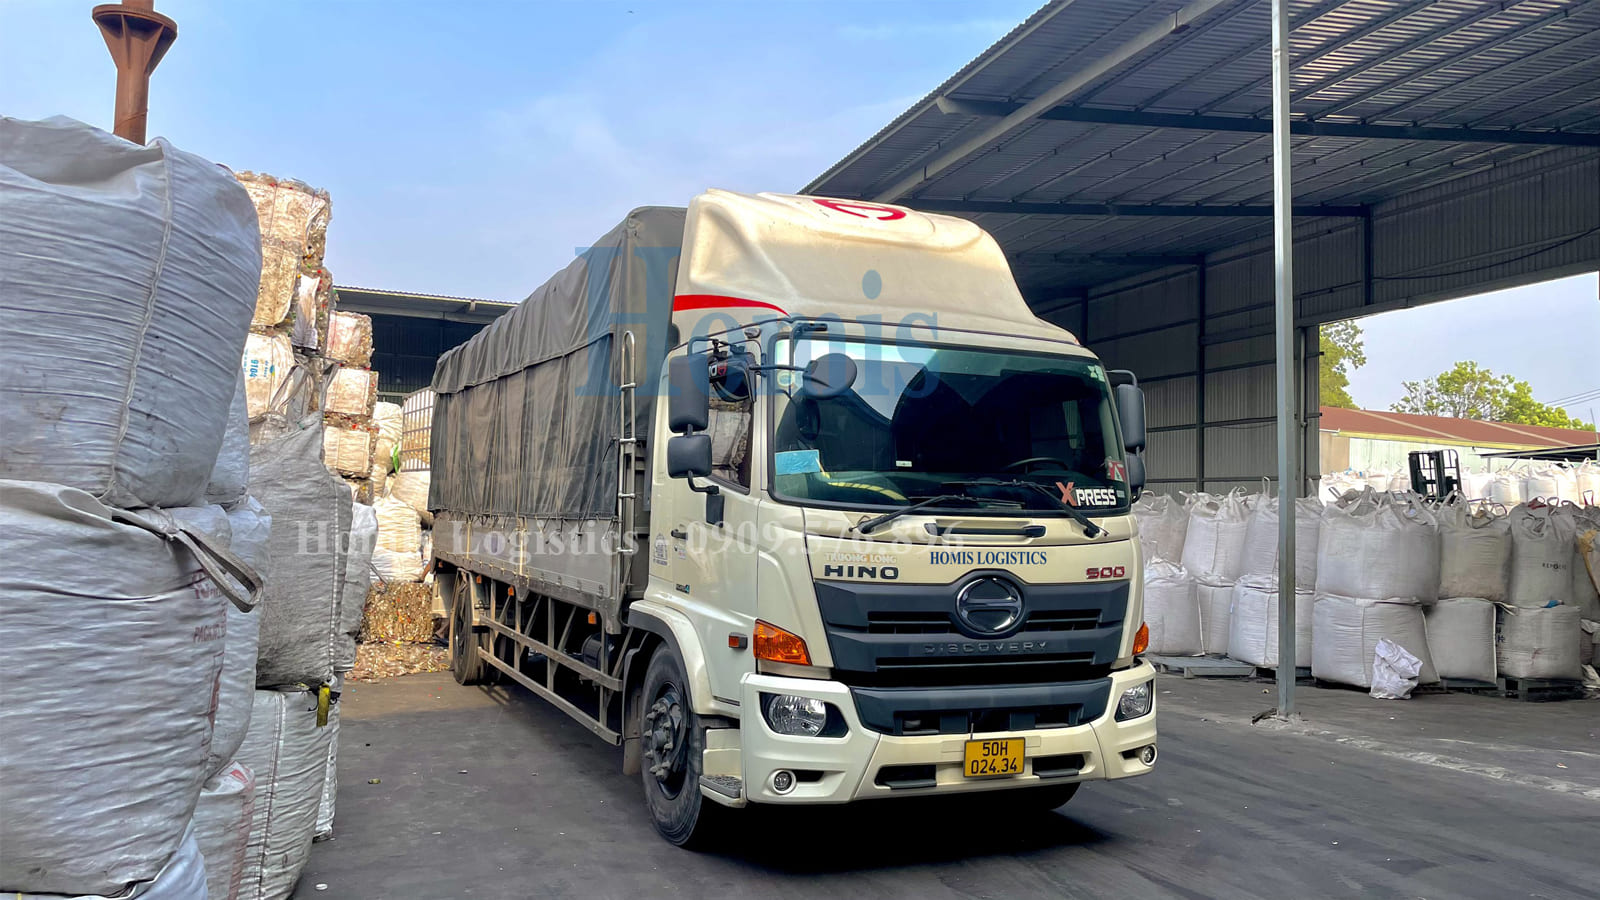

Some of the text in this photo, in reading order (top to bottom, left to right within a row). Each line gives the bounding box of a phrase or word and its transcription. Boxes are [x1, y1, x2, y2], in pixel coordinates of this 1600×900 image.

[249, 359, 259, 378] 9104
[869, 553, 897, 564] LONG
[930, 551, 1048, 565] HOMIS LOGISTICS
[824, 564, 899, 580] HINO
[1085, 566, 1125, 579] 500
[924, 641, 1047, 654] DISCOVERY
[982, 741, 1008, 757] 50H
[971, 757, 1018, 775] 024.34
